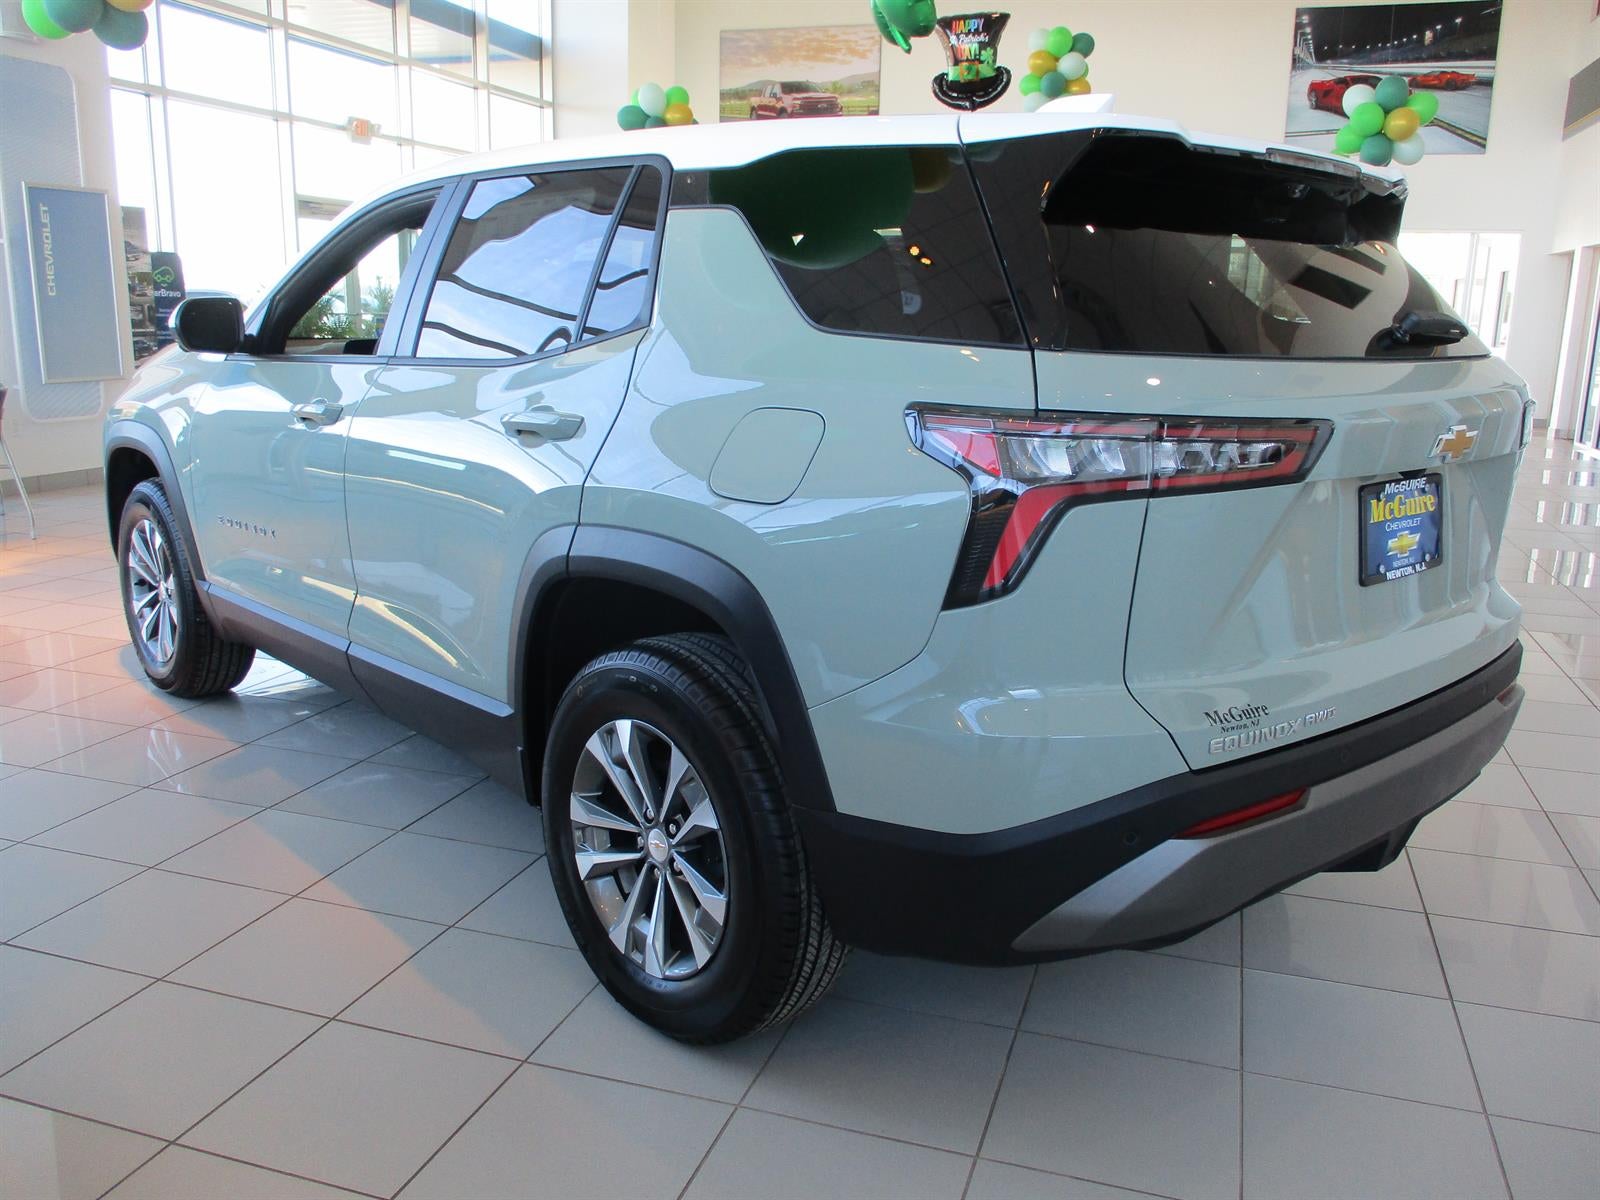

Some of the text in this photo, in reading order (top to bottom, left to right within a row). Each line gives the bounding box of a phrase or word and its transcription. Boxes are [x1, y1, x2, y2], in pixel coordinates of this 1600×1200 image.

[951, 18, 984, 34] HAPPY
[956, 43, 979, 60] DAY!
[40, 203, 56, 296] CHEVROLET
[1384, 477, 1427, 495] McGUIRE
[1370, 494, 1436, 523] McGuire
[1385, 517, 1422, 532] CHEVROLET
[1204, 703, 1270, 727] McGuire
[1209, 719, 1301, 754] EQUINOX
[1220, 721, 1250, 734] Newton,
